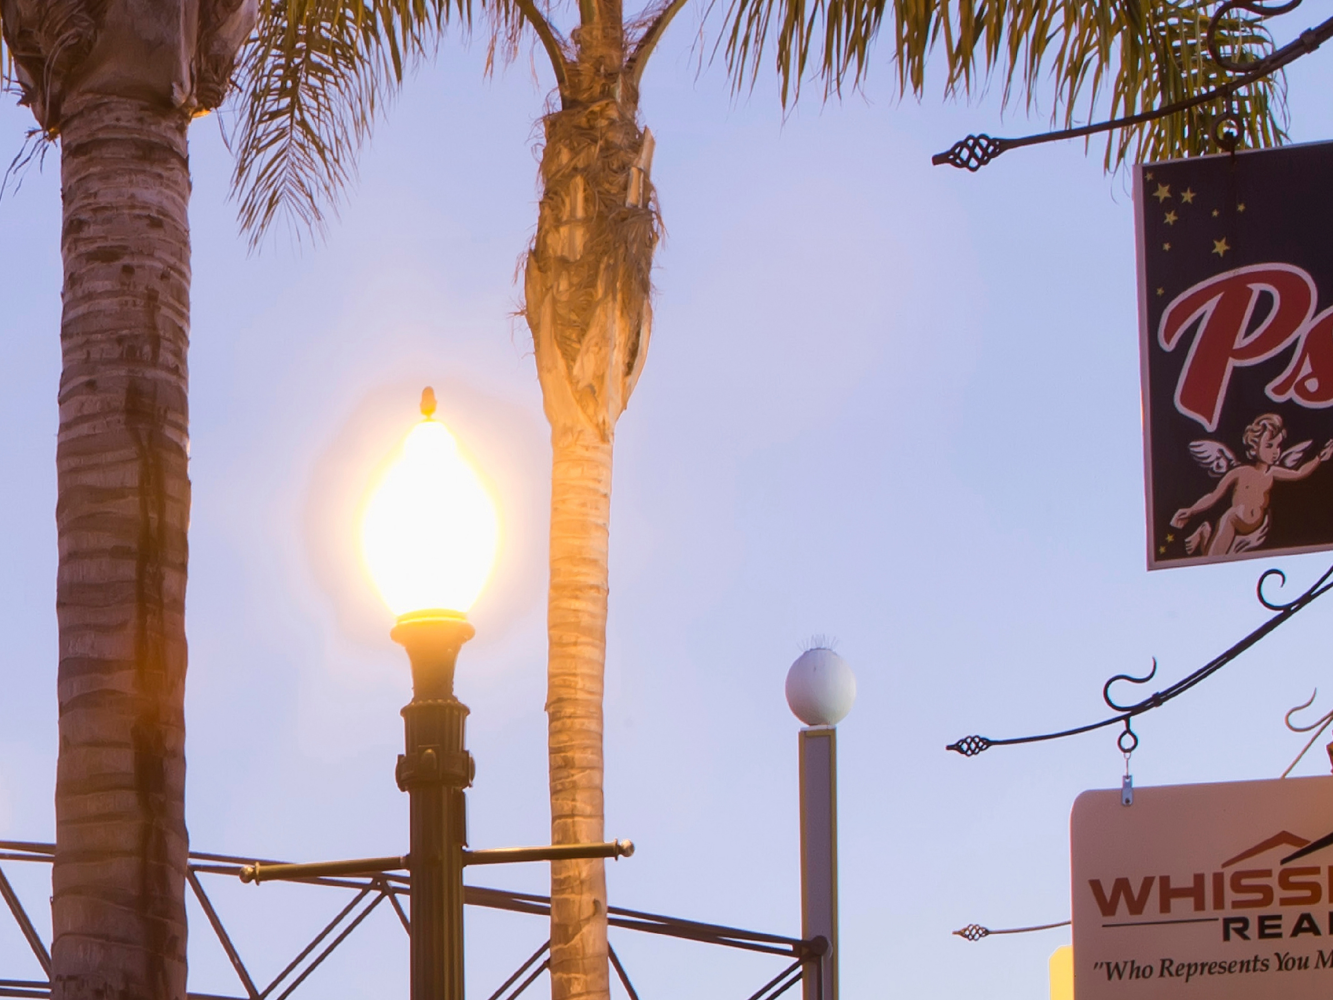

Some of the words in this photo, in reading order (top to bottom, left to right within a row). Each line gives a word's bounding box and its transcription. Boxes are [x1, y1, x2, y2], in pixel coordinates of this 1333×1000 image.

[1088, 865, 1333, 917] WHISS
[1222, 911, 1333, 942] REA
[1158, 953, 1270, 983] Represents
[1273, 951, 1310, 972] You
